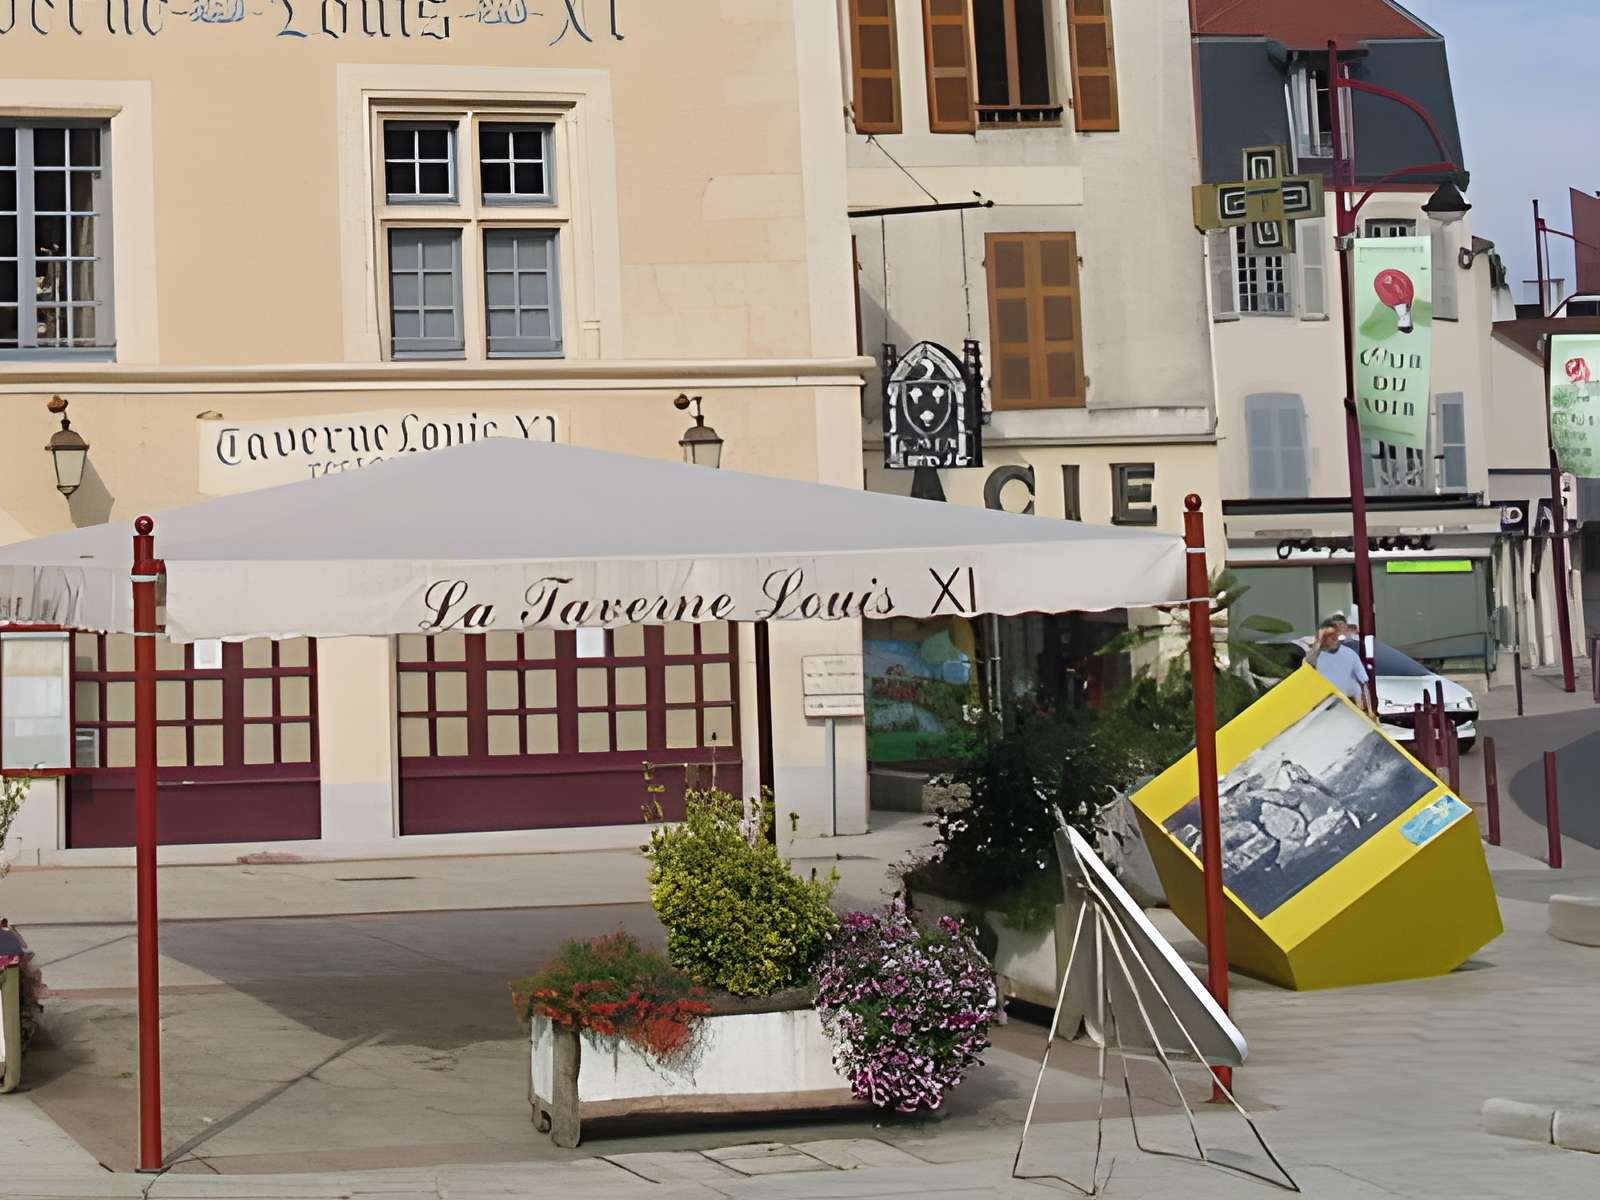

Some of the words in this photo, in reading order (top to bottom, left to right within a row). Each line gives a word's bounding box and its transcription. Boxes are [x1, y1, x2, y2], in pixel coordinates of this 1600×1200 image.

[216, 423, 389, 466] Taverne
[418, 578, 495, 632] La
[520, 576, 736, 628] Taverne
[754, 567, 897, 621] Louis
[928, 566, 978, 617] XI
